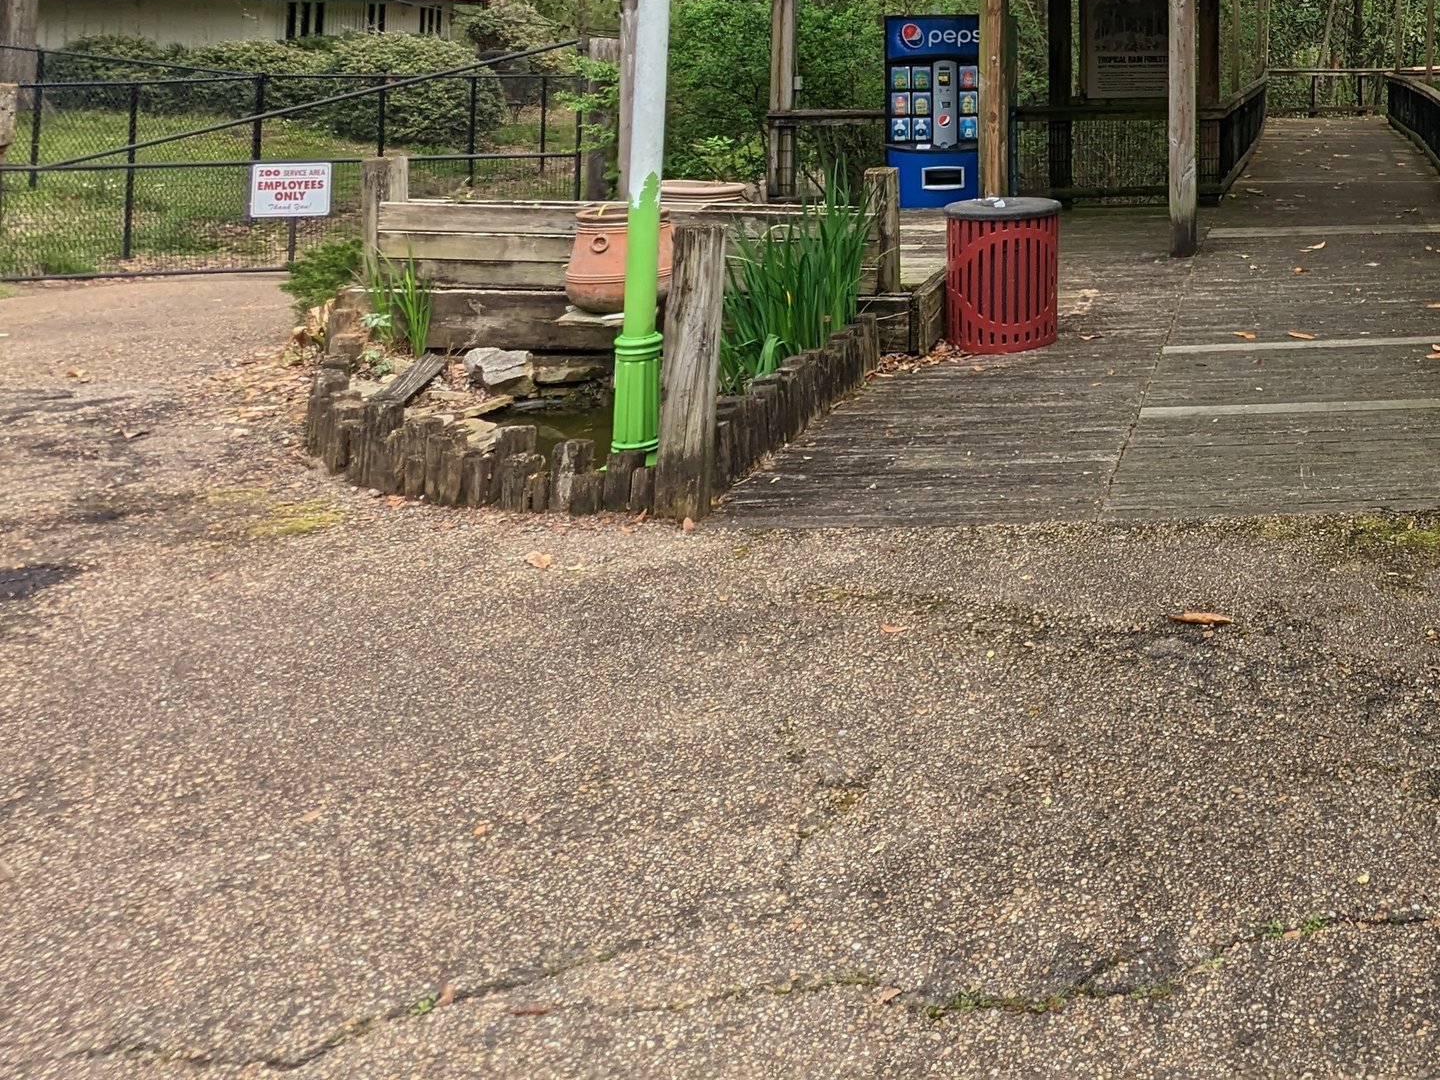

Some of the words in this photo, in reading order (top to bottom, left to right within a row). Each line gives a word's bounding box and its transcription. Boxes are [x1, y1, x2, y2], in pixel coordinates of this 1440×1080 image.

[928, 29, 980, 48] peps
[259, 169, 281, 177] ZOO
[283, 169, 307, 177] SERVICE
[257, 180, 324, 191] EMPLOYEES
[274, 192, 306, 201] ONLY
[268, 203, 291, 211] Thank
